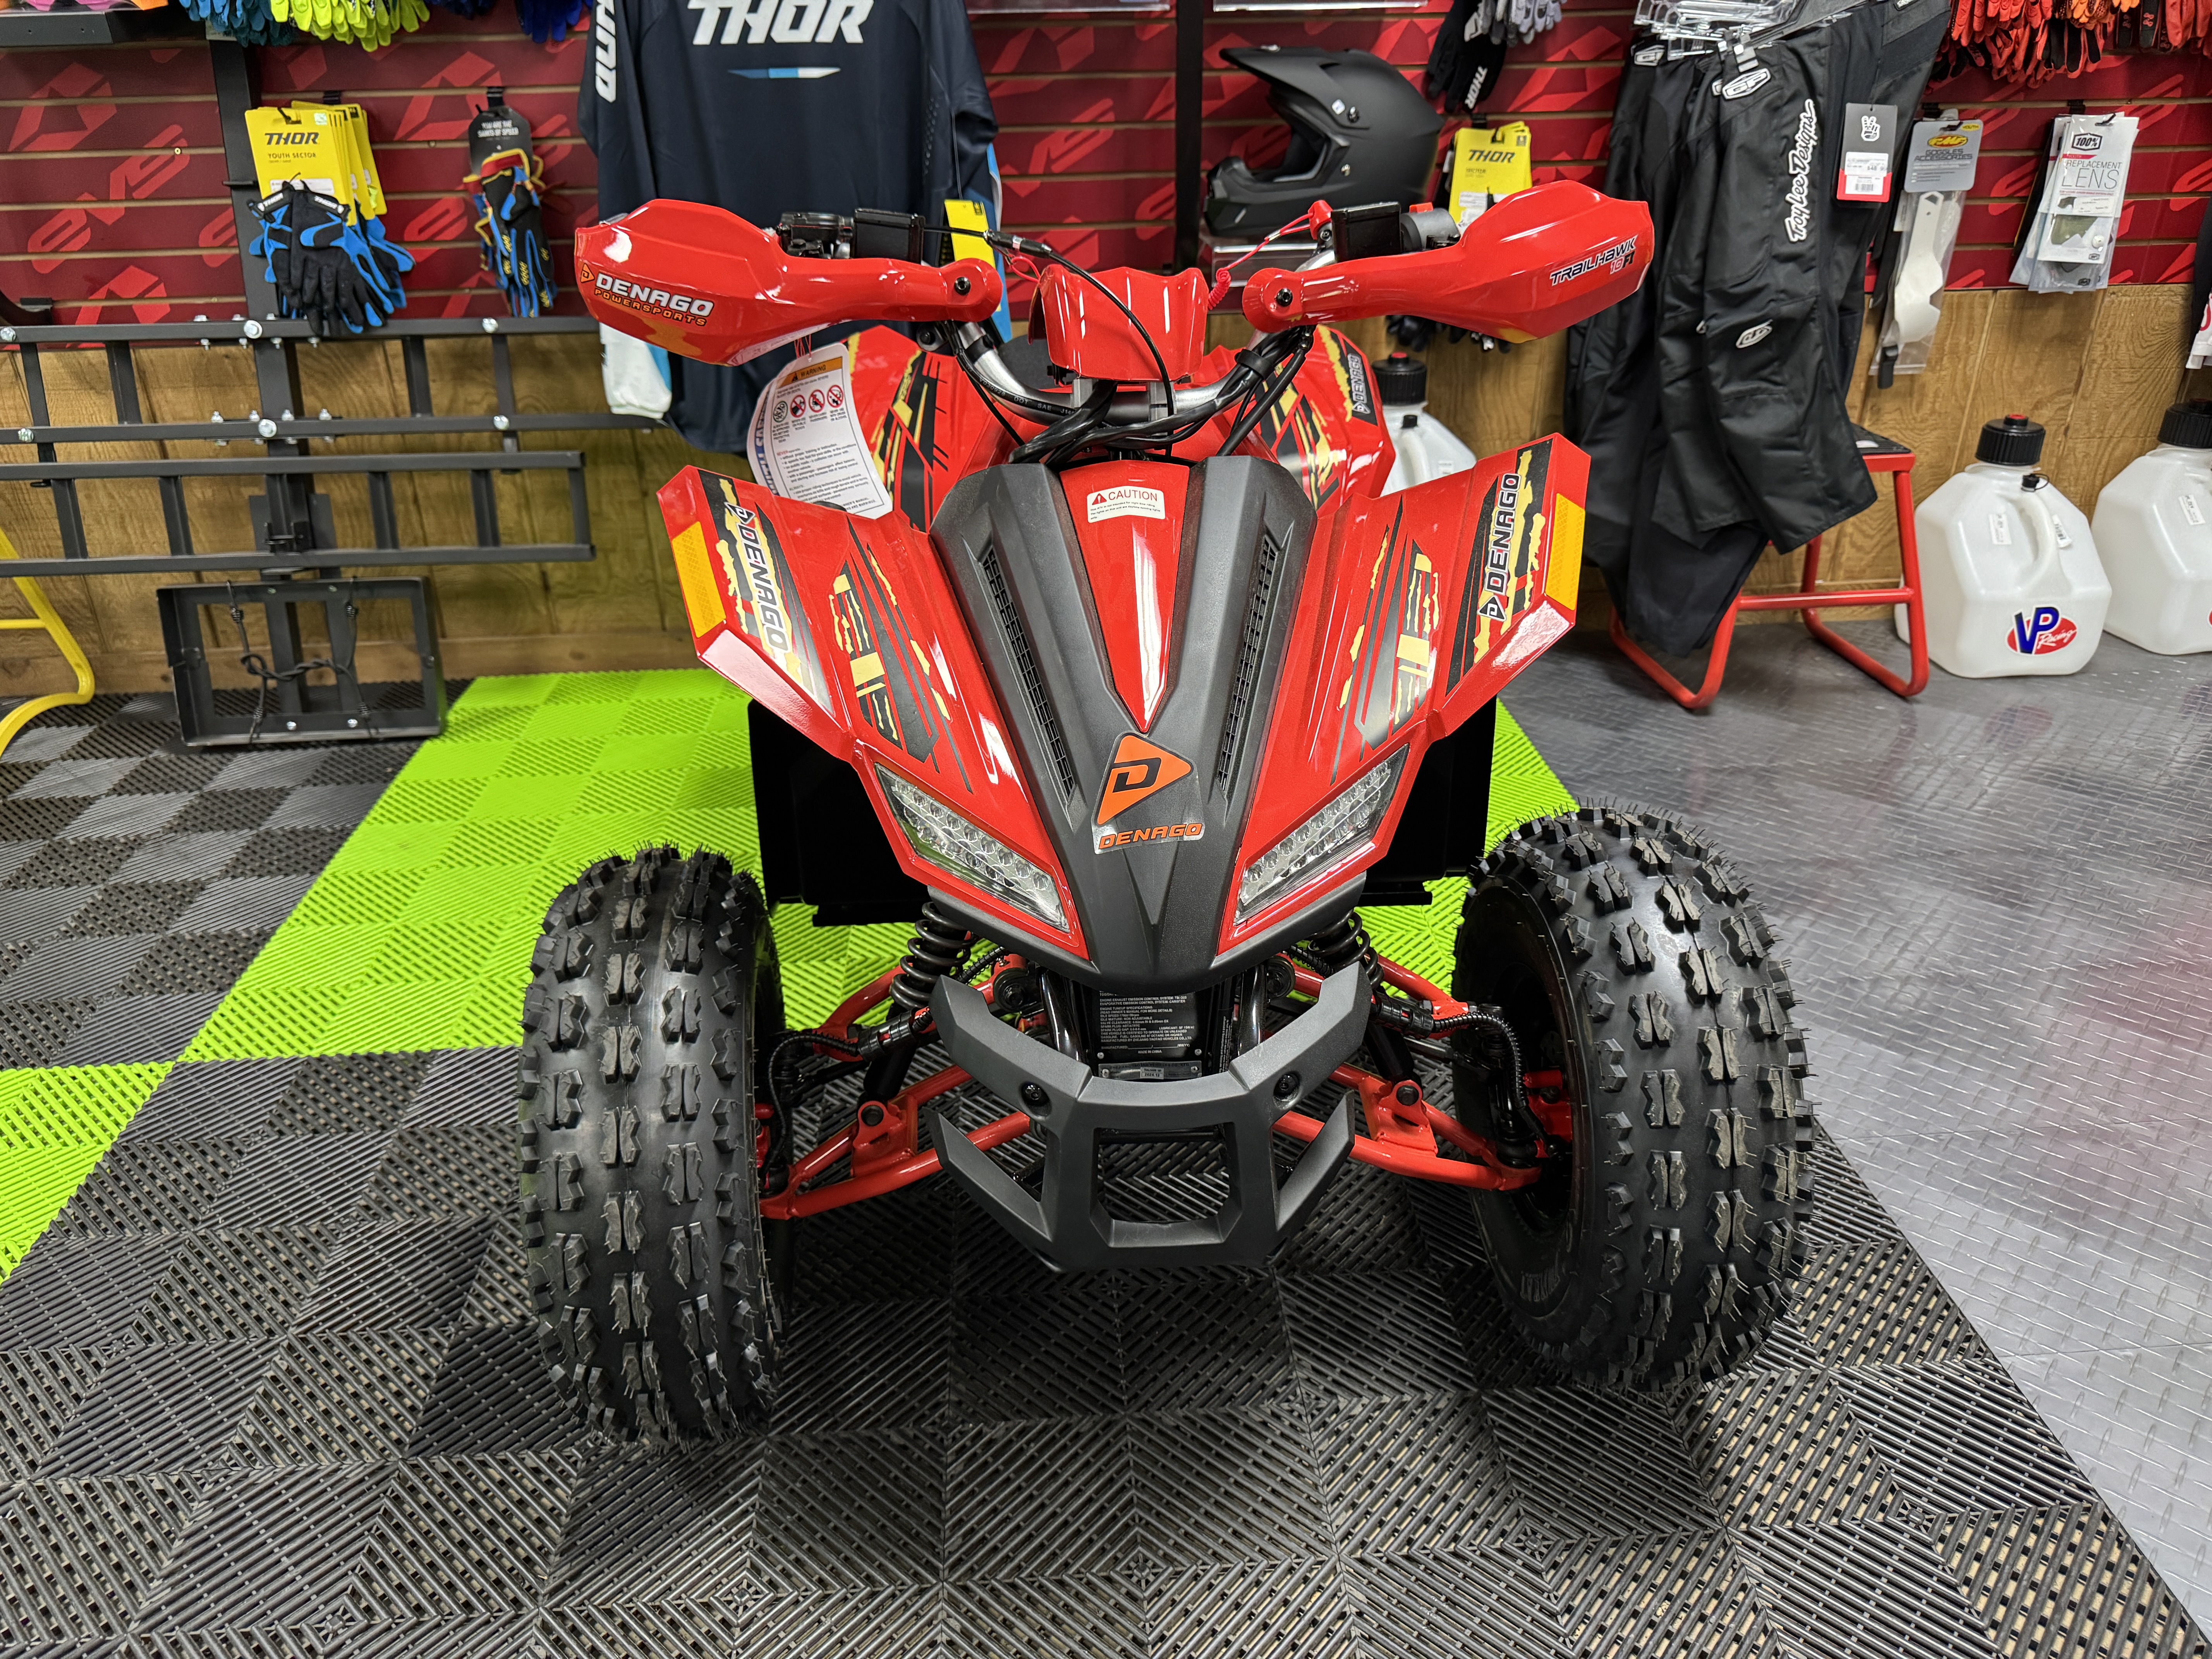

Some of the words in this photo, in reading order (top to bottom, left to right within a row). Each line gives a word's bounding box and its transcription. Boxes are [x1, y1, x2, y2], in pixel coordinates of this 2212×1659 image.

[687, 0, 874, 45] THOR
[1464, 65, 1488, 109] THOR
[501, 127, 519, 136] SPEED
[502, 120, 512, 128] THE
[264, 132, 319, 146] THOR
[1788, 99, 1818, 175] Designs
[1928, 136, 1968, 146] FMF
[2075, 137, 2099, 147] 100%
[1469, 149, 1515, 163] THOR
[2066, 160, 2123, 169] REPLACEMENT
[2061, 168, 2119, 189] LENS
[596, 272, 714, 317] DENAGO
[594, 287, 707, 326] POWERSPORTS
[800, 364, 826, 377] WARNING
[1014, 395, 1029, 404] DOT
[1109, 489, 1157, 501] CAUTION
[1484, 473, 1522, 596] DENAGO
[736, 523, 791, 653] DENAGO
[2014, 606, 2060, 654] VP
[2036, 629, 2078, 649] Racing
[1098, 823, 1203, 850] DENAGO
